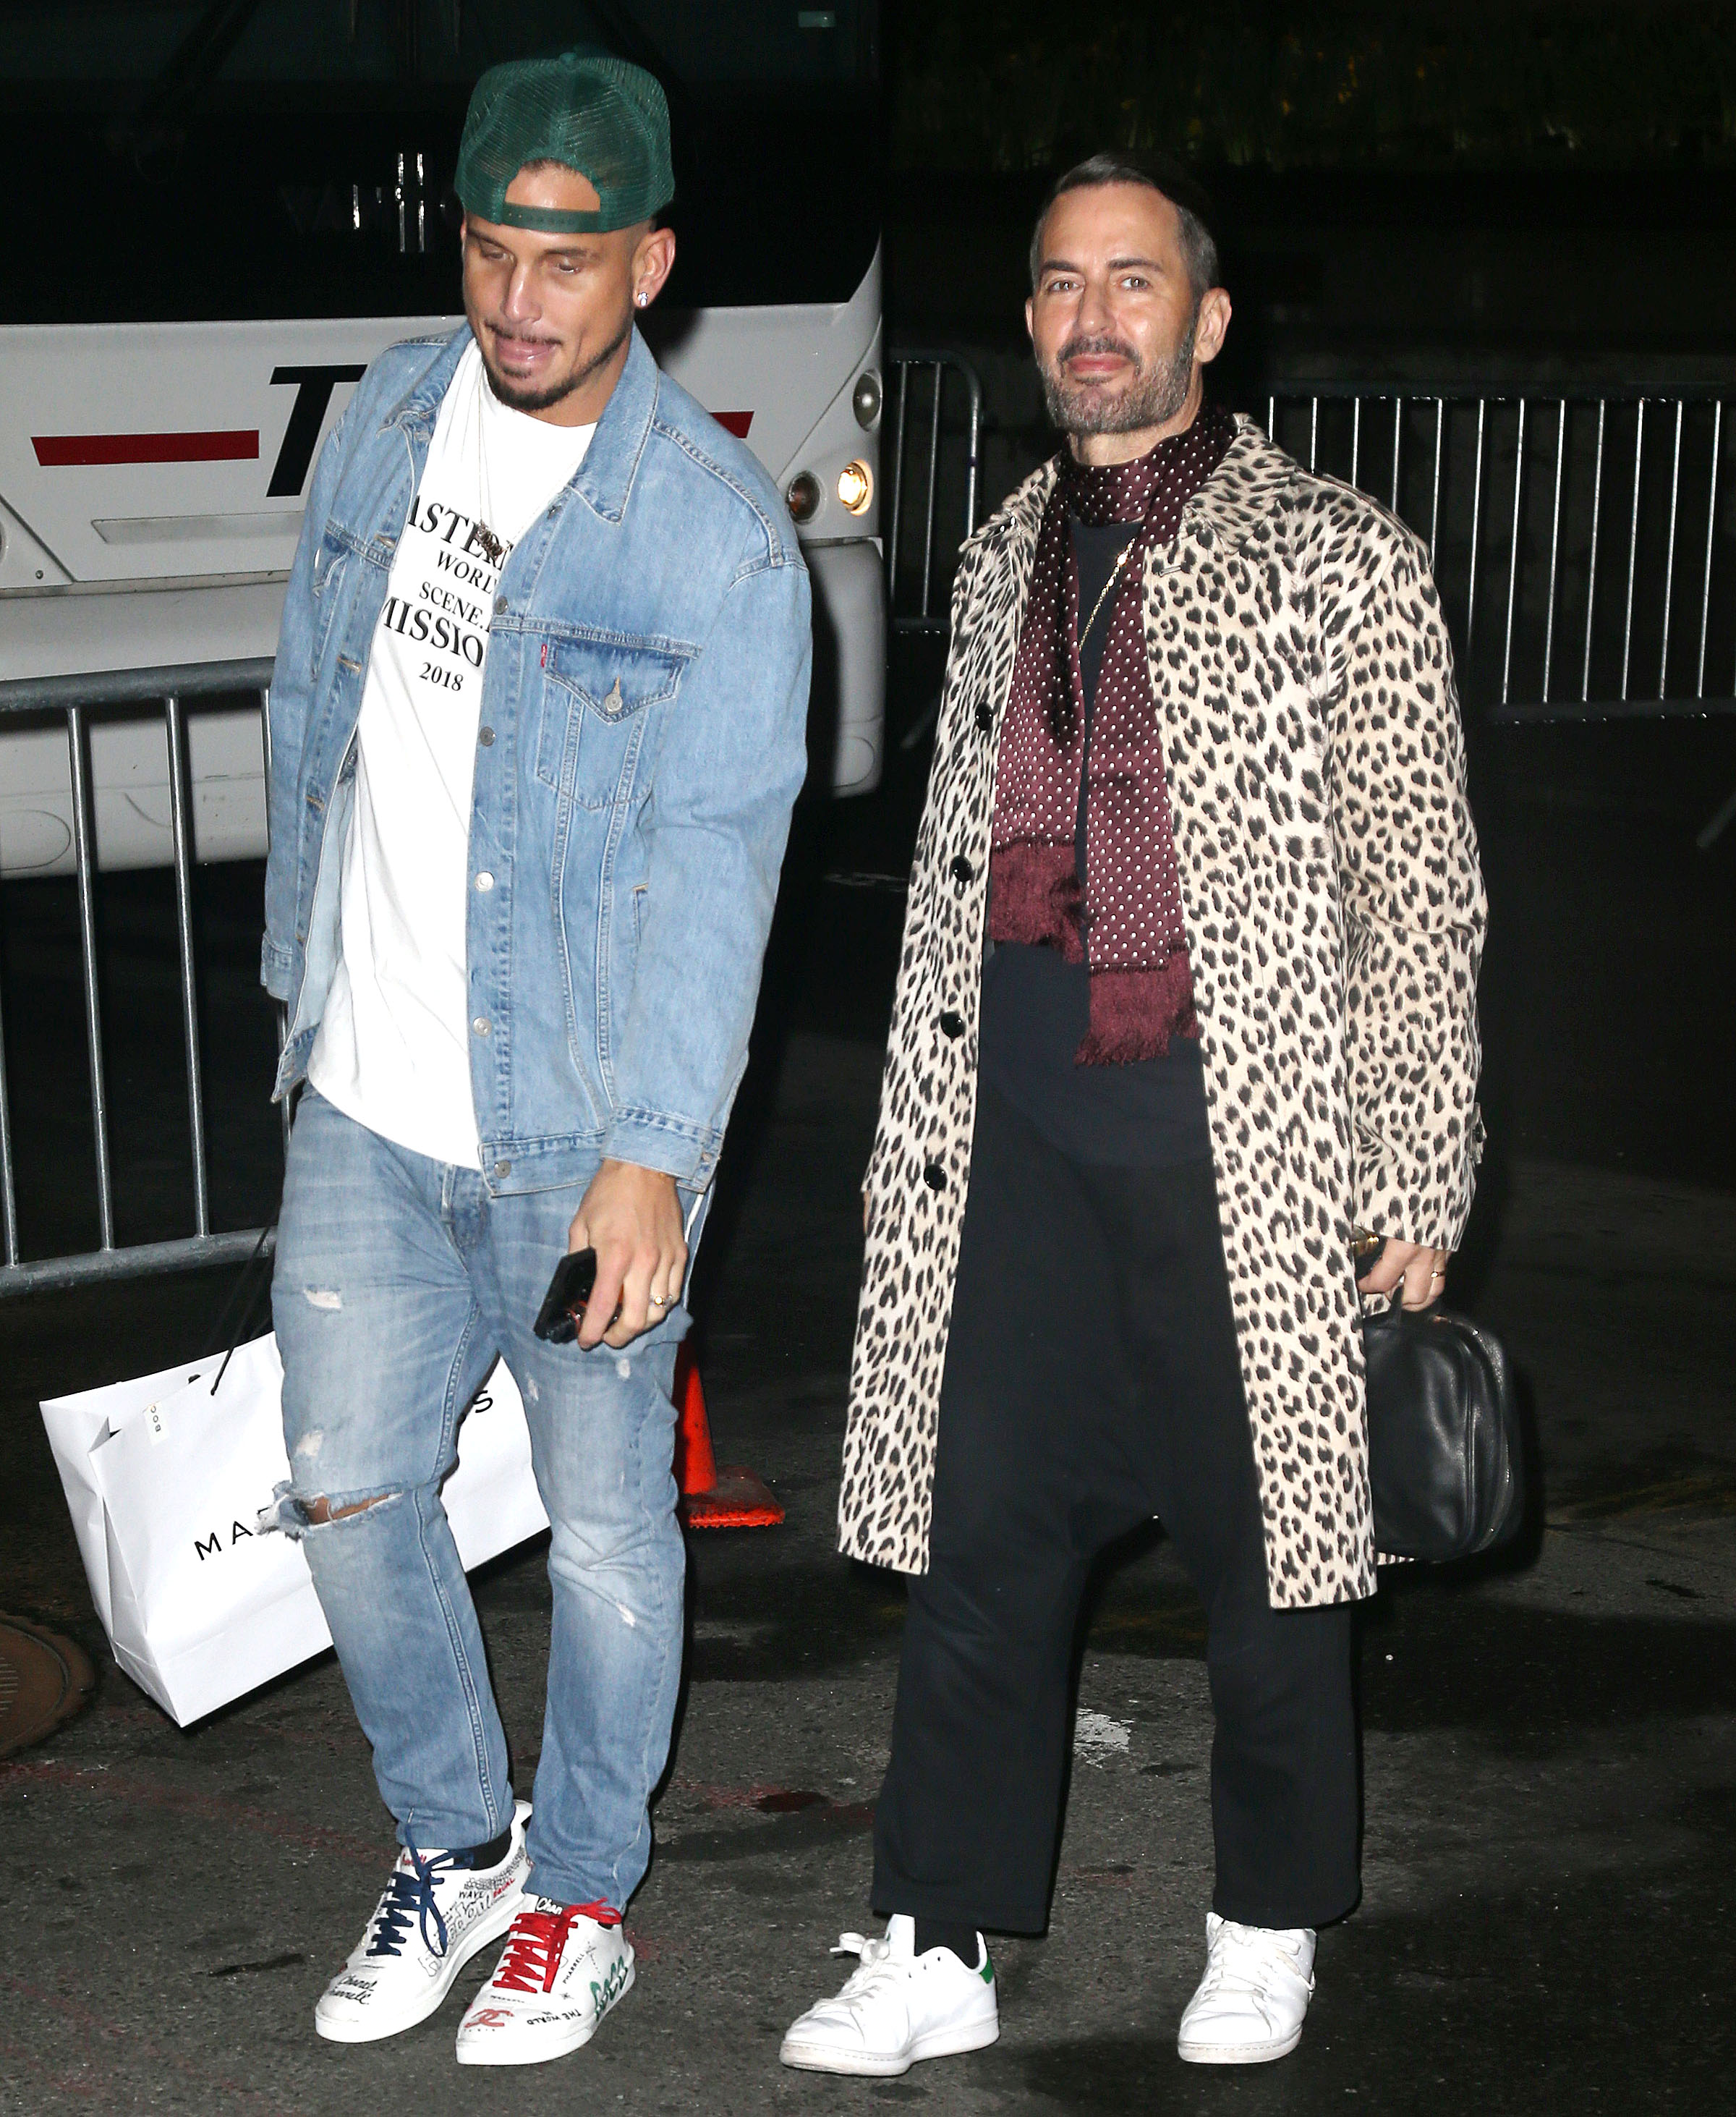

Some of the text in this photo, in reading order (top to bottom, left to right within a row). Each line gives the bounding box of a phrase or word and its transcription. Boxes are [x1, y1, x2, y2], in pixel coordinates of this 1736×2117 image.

[437, 550, 497, 594] WORL
[419, 661, 464, 692] 2018
[459, 1890, 484, 1898] WAVE
[563, 1953, 585, 1984] PHARRELL
[527, 2014, 559, 2025] WORLD
[562, 2008, 582, 2020] THE
